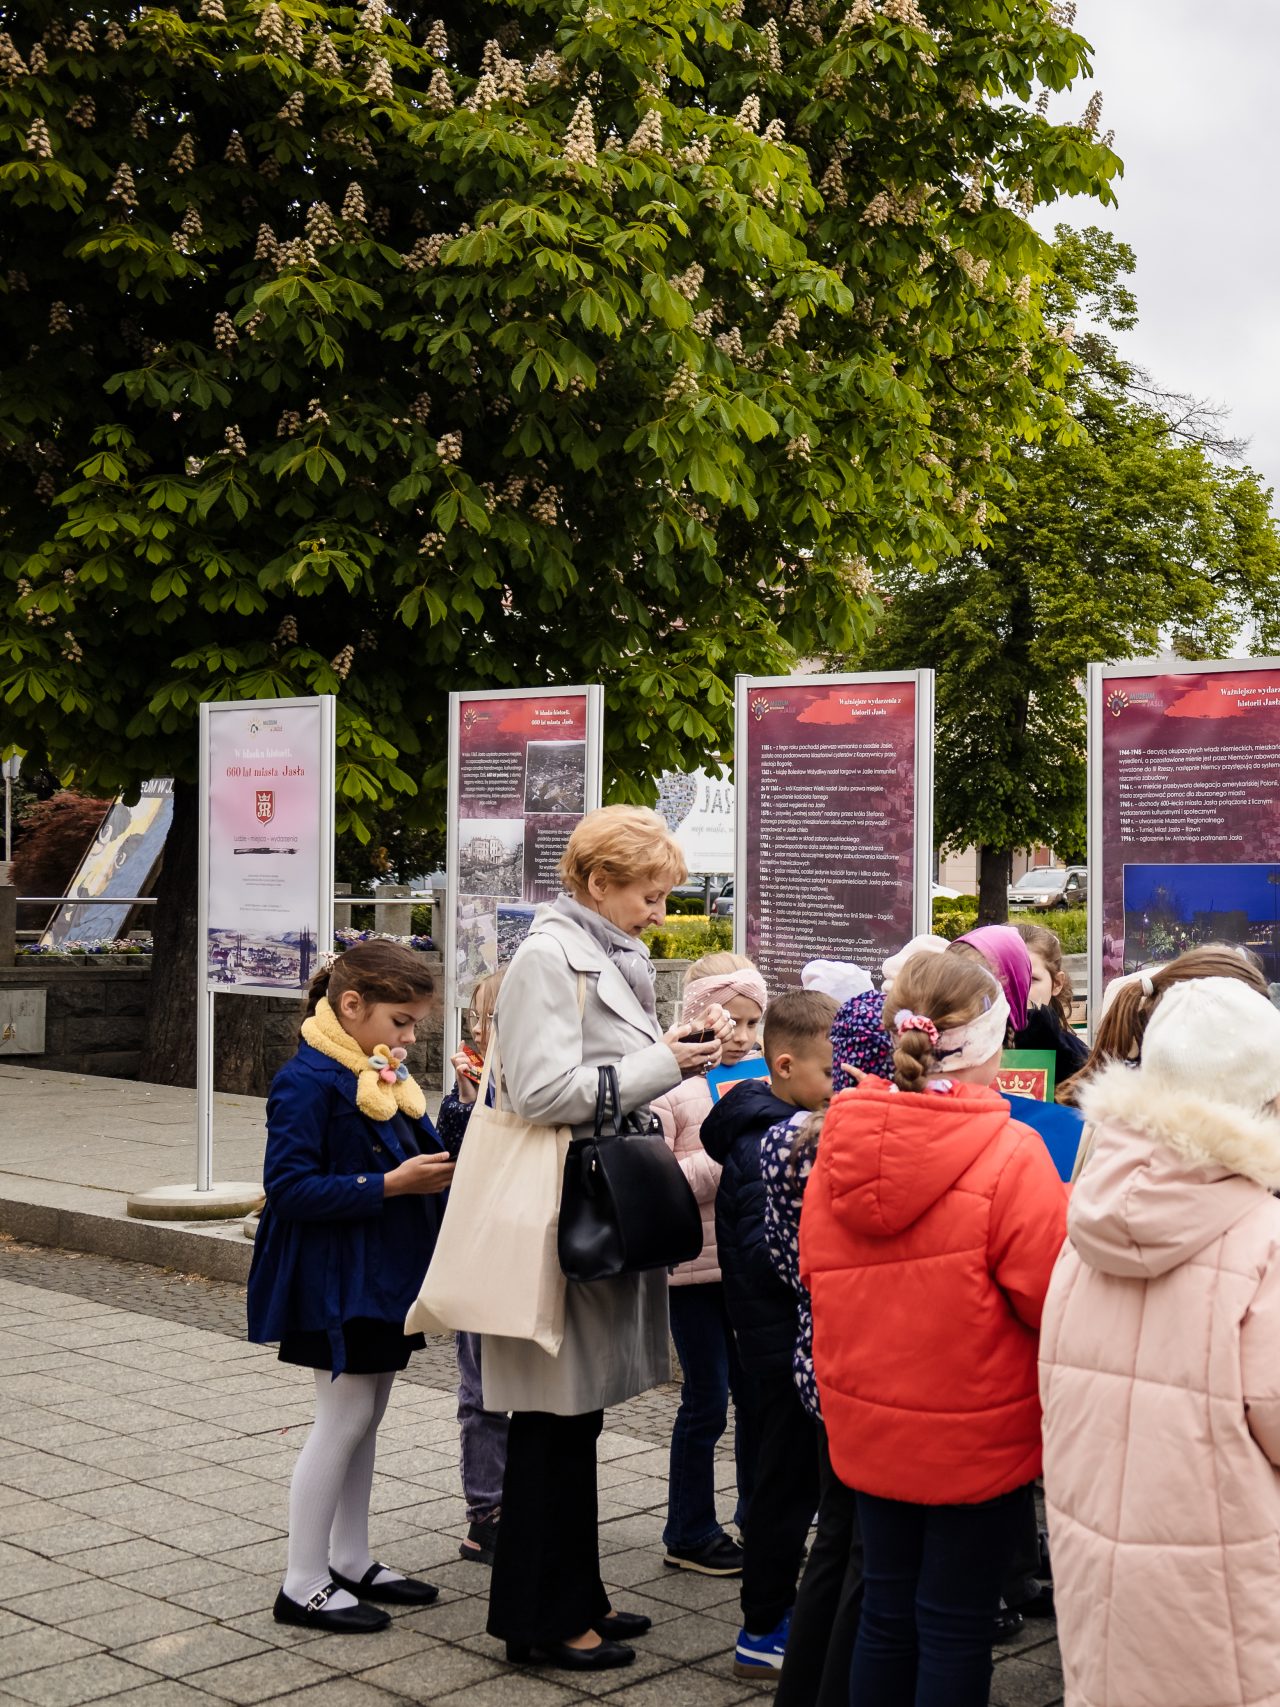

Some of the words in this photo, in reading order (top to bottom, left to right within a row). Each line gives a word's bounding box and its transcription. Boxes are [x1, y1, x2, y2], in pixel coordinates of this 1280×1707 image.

[1220, 687, 1256, 698] Ważniejsze
[839, 698, 867, 706] Ważniejsze
[868, 697, 897, 706] wydarzenia
[1237, 699, 1262, 707] historii
[226, 766, 241, 776] 660
[242, 767, 252, 776] lat
[254, 767, 278, 776] miasta
[282, 764, 305, 776] Jasła
